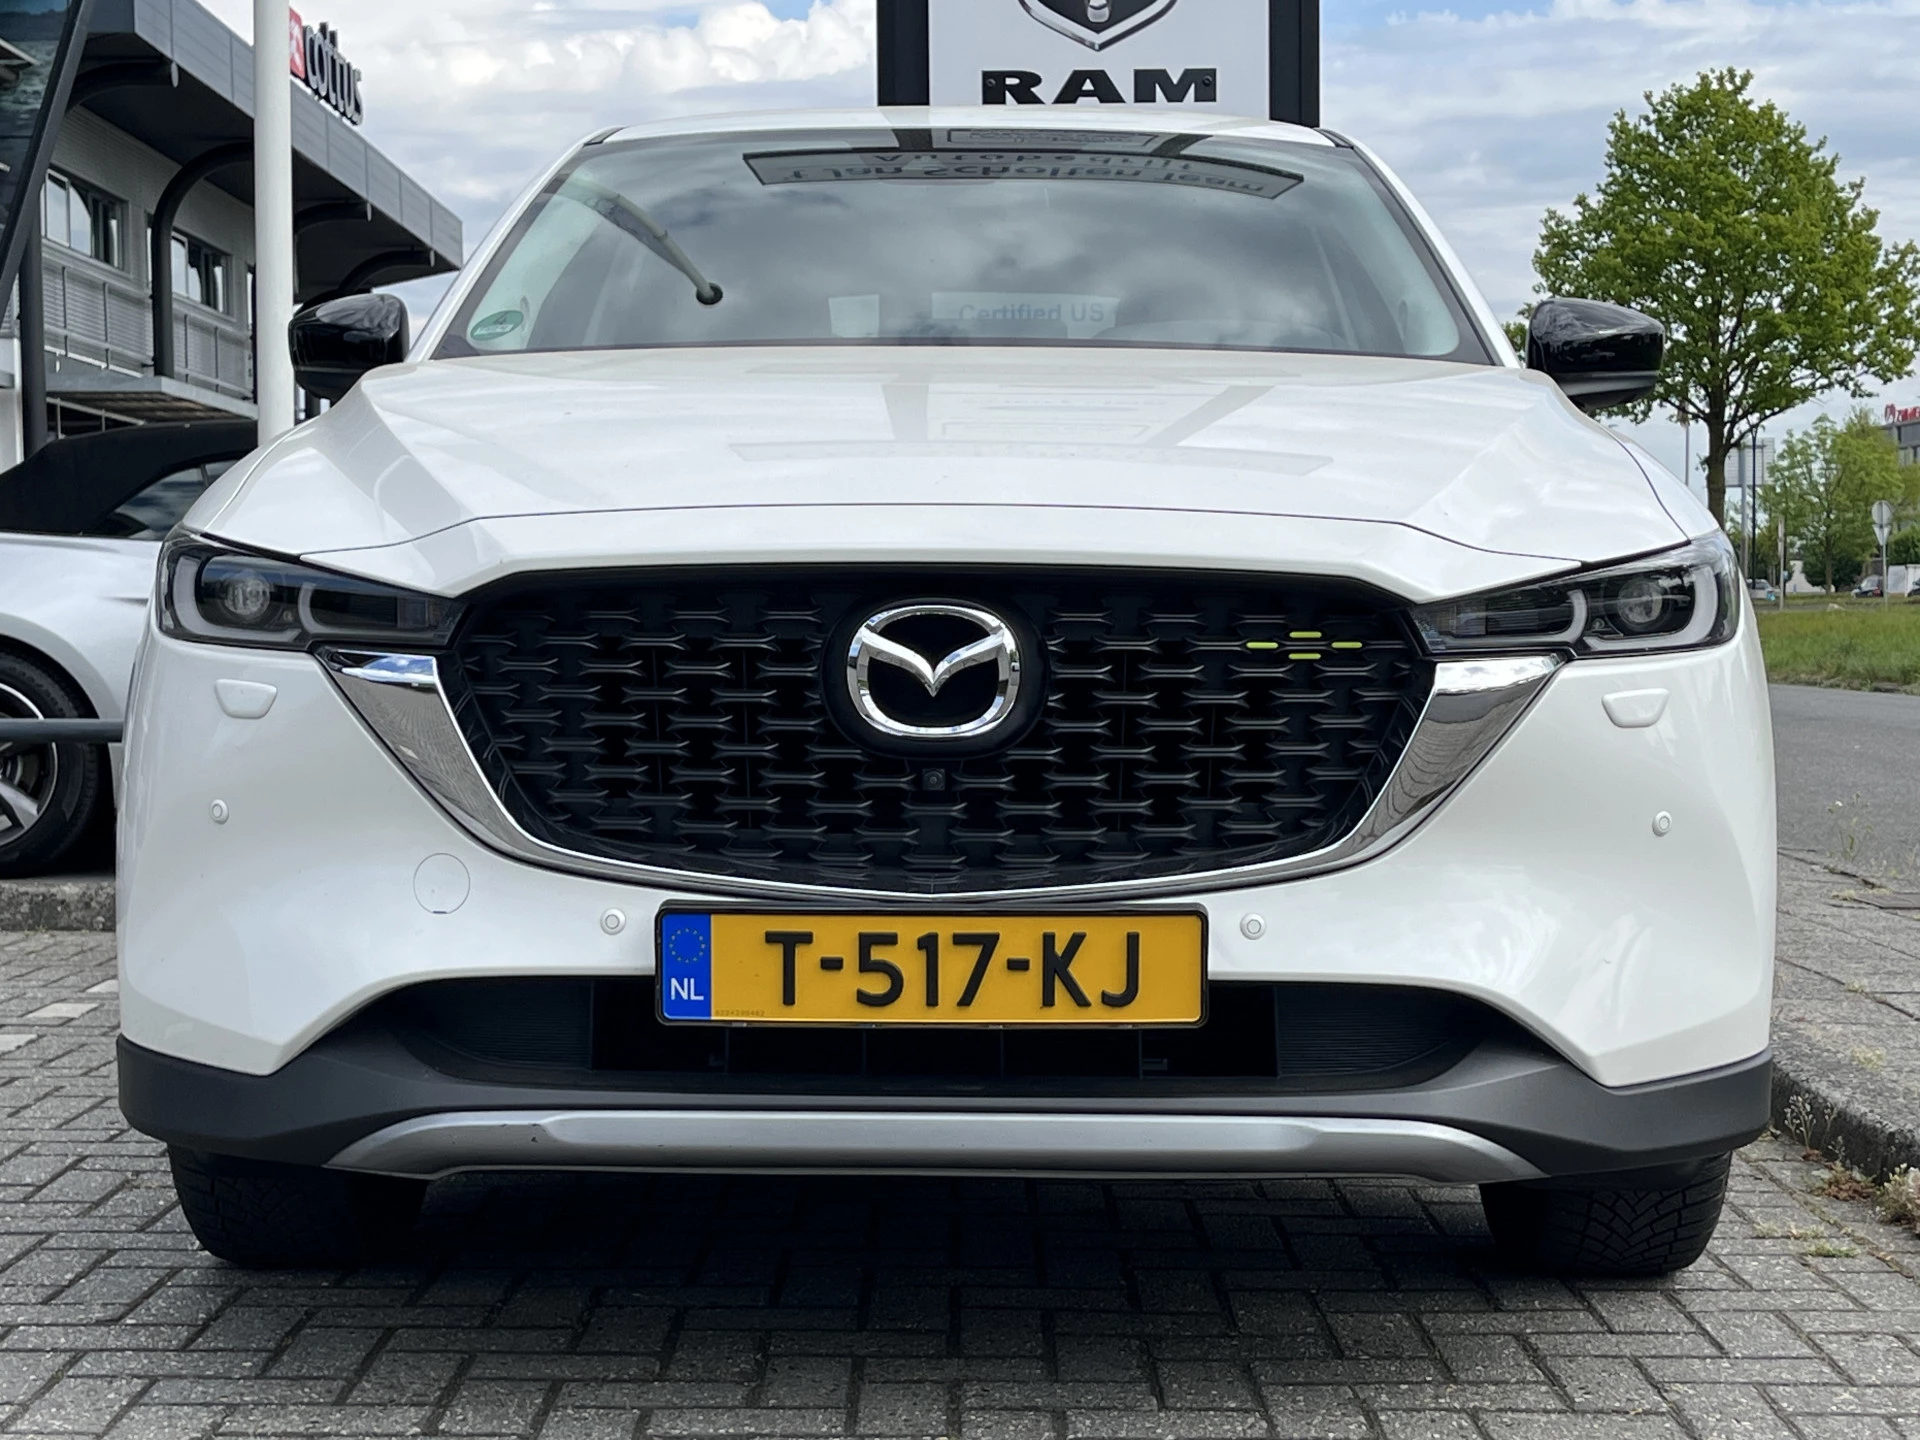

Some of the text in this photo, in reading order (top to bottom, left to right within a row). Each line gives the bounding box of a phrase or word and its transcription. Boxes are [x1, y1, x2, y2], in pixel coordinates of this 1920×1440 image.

[981, 67, 1217, 105] RAM
[958, 302, 1105, 324] Certified US
[765, 930, 1139, 1008] T-517-KJ
[670, 977, 704, 1001] NL
